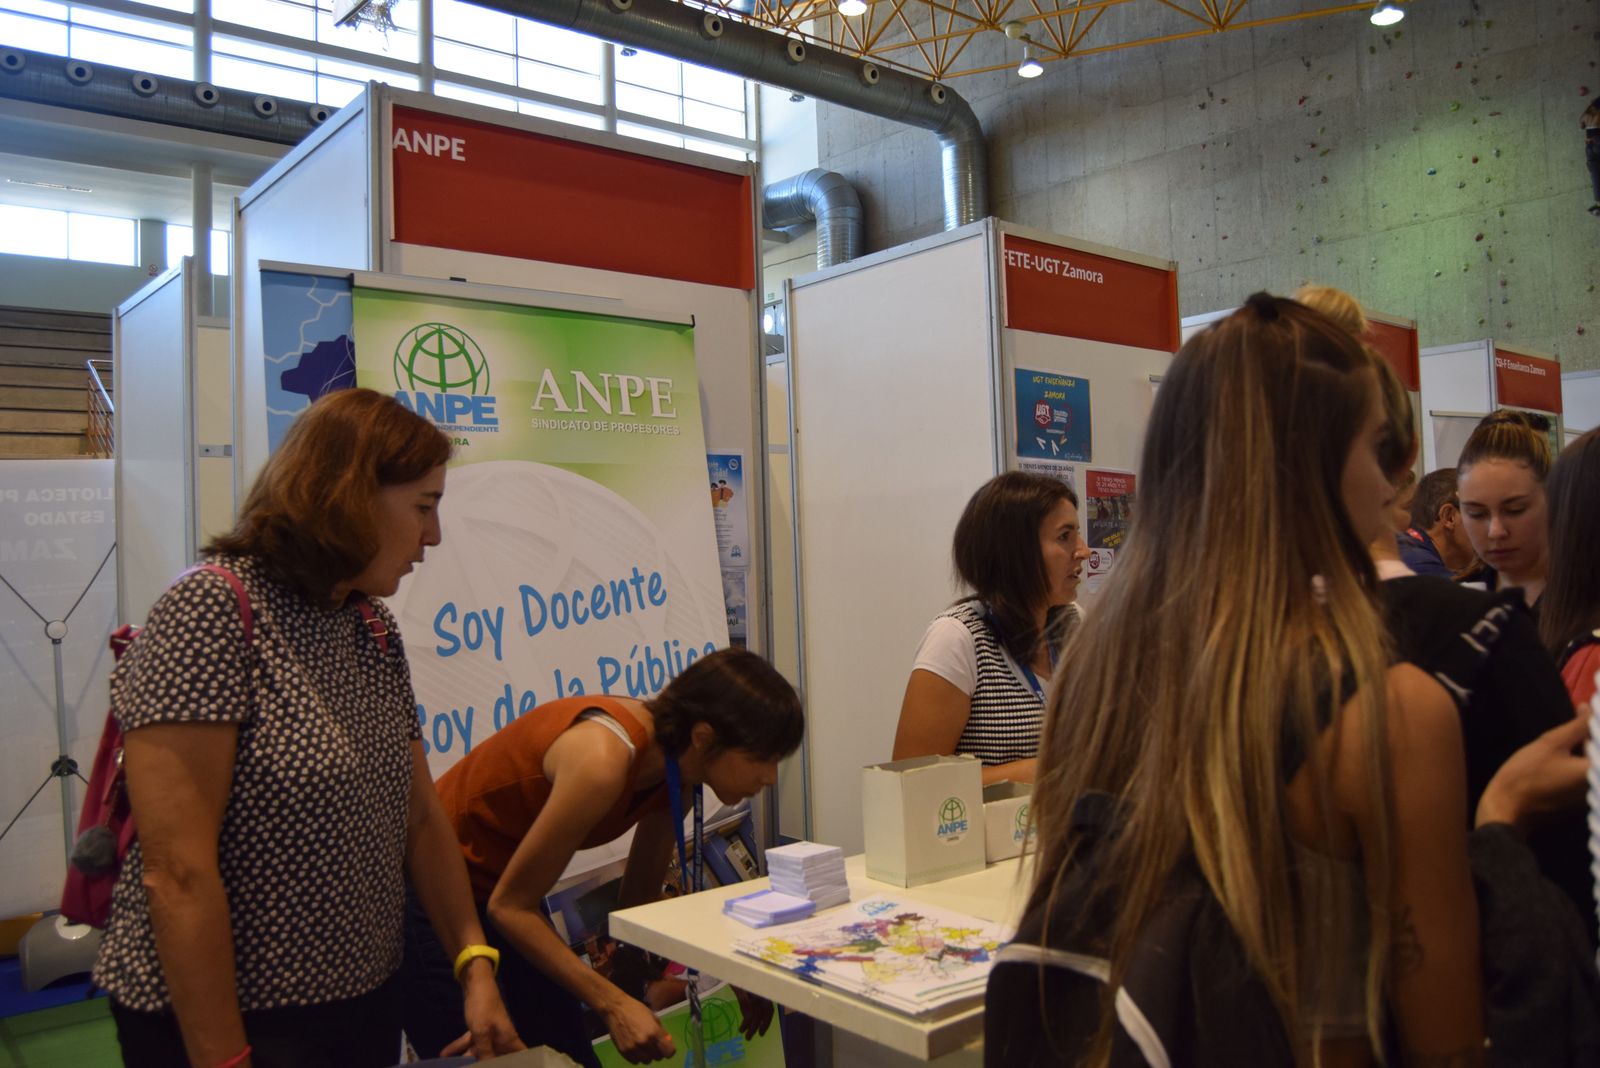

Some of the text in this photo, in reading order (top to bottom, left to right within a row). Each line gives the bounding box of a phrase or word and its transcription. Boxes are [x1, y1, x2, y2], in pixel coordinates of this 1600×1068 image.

[392, 127, 466, 162] ANPE
[1062, 261, 1104, 284] Zamora
[531, 368, 677, 418] ANPE
[1036, 403, 1050, 416] UGT
[531, 418, 681, 436] SINDICATO DE PROFESORES
[433, 567, 667, 661] Soy Docente
[597, 639, 718, 700] Públic
[937, 819, 969, 836] ANPE
